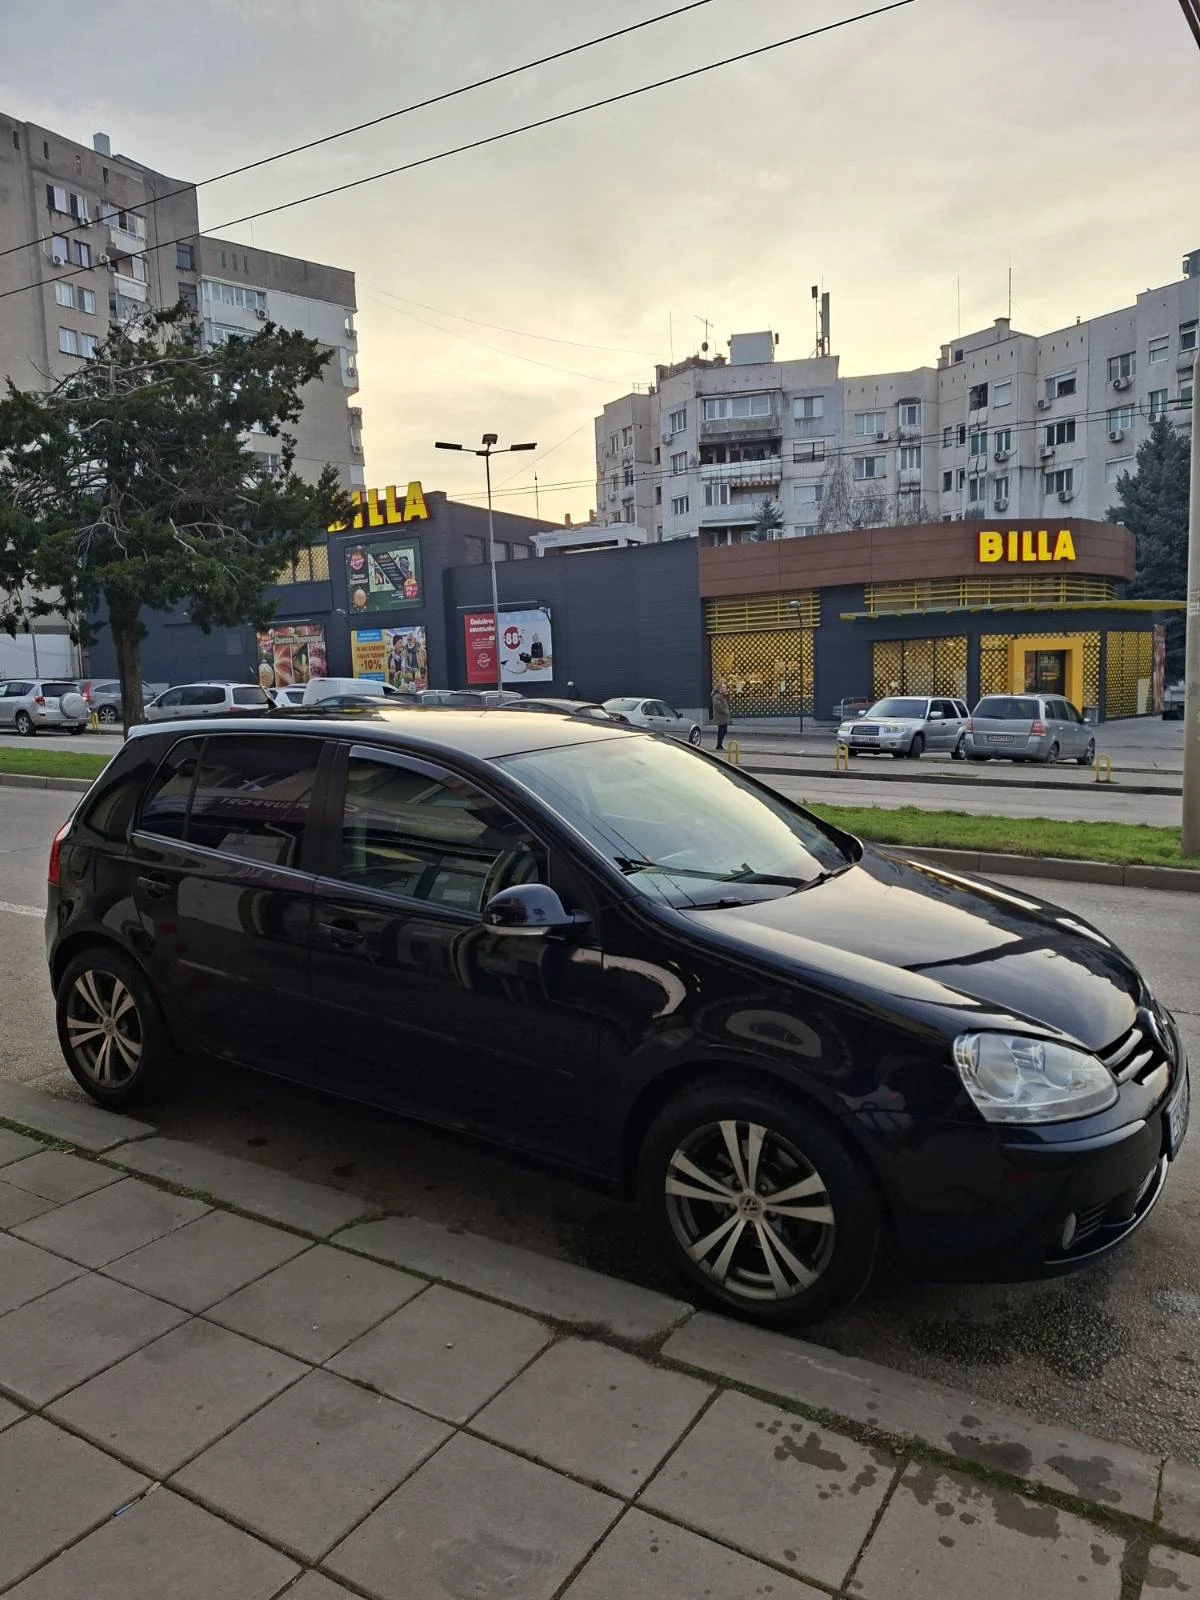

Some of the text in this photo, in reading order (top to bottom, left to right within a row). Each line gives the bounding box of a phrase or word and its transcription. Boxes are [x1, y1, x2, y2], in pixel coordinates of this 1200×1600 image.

[327, 480, 429, 533] ILLA
[978, 529, 1077, 563] BILLA
[361, 658, 382, 670] -10%
